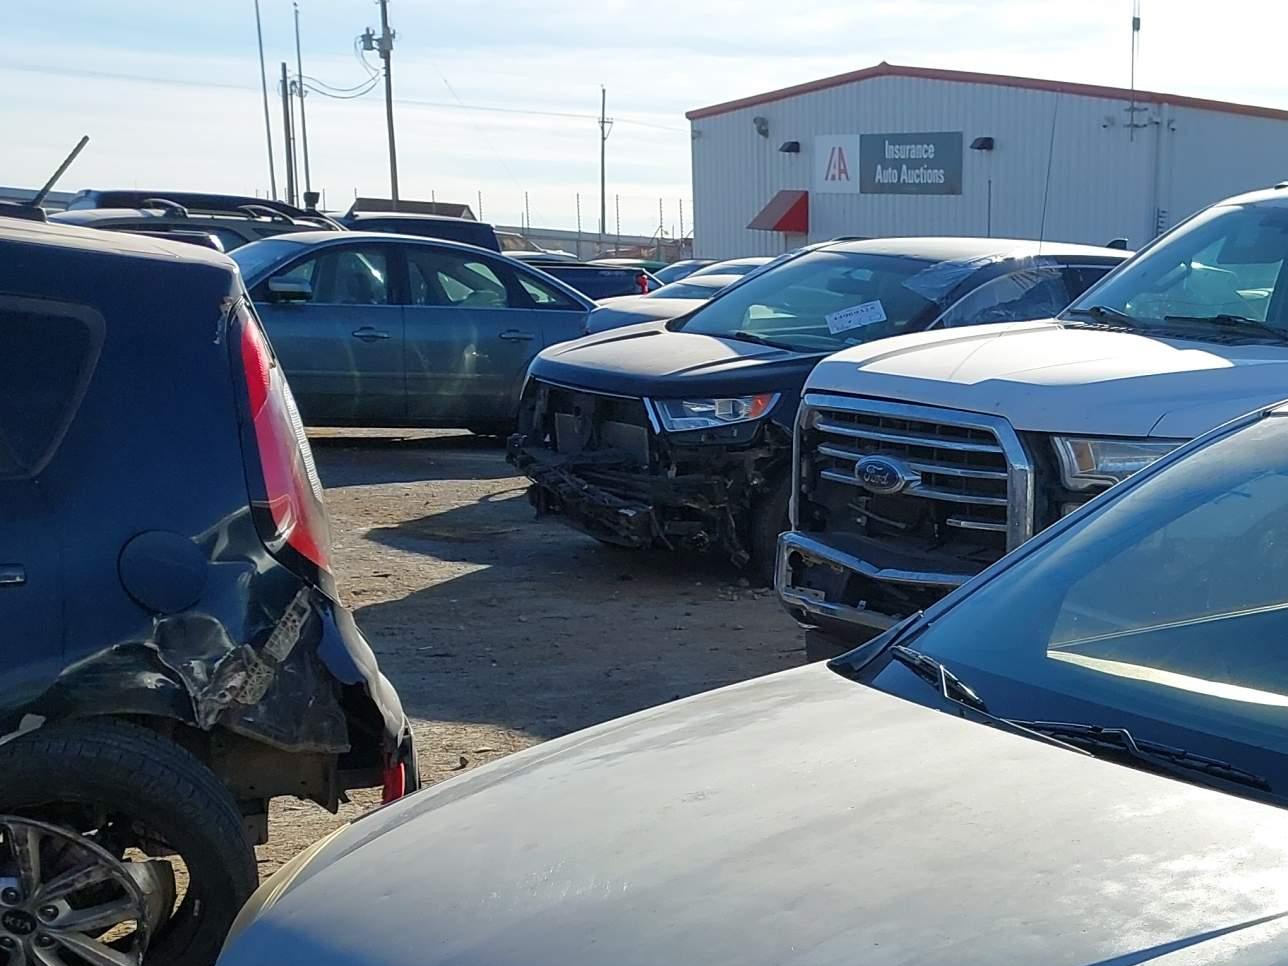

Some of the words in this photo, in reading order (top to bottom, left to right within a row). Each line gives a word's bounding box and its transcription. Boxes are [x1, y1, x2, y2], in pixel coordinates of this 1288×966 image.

[885, 139, 935, 160] Insurance
[875, 163, 898, 184] Auto
[900, 163, 945, 184] Auctions
[863, 464, 890, 485] Ford
